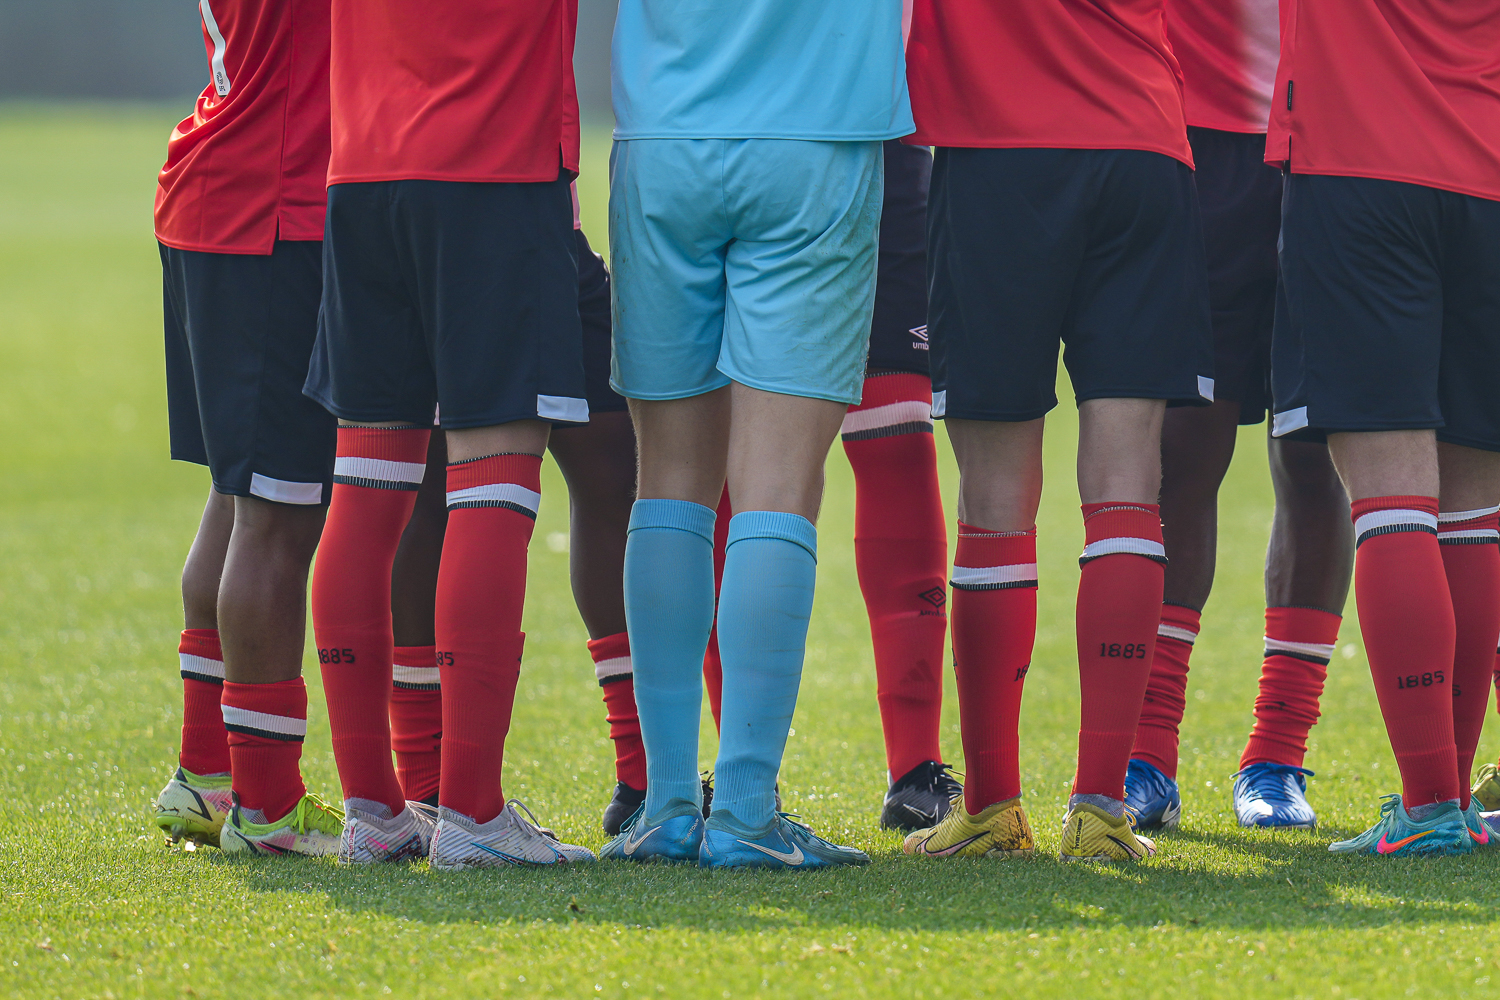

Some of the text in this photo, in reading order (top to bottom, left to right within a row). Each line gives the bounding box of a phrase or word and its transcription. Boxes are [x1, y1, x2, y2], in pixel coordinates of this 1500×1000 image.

[912, 341, 930, 350] umb
[1100, 642, 1147, 659] 1885
[1397, 670, 1446, 690] 1885
